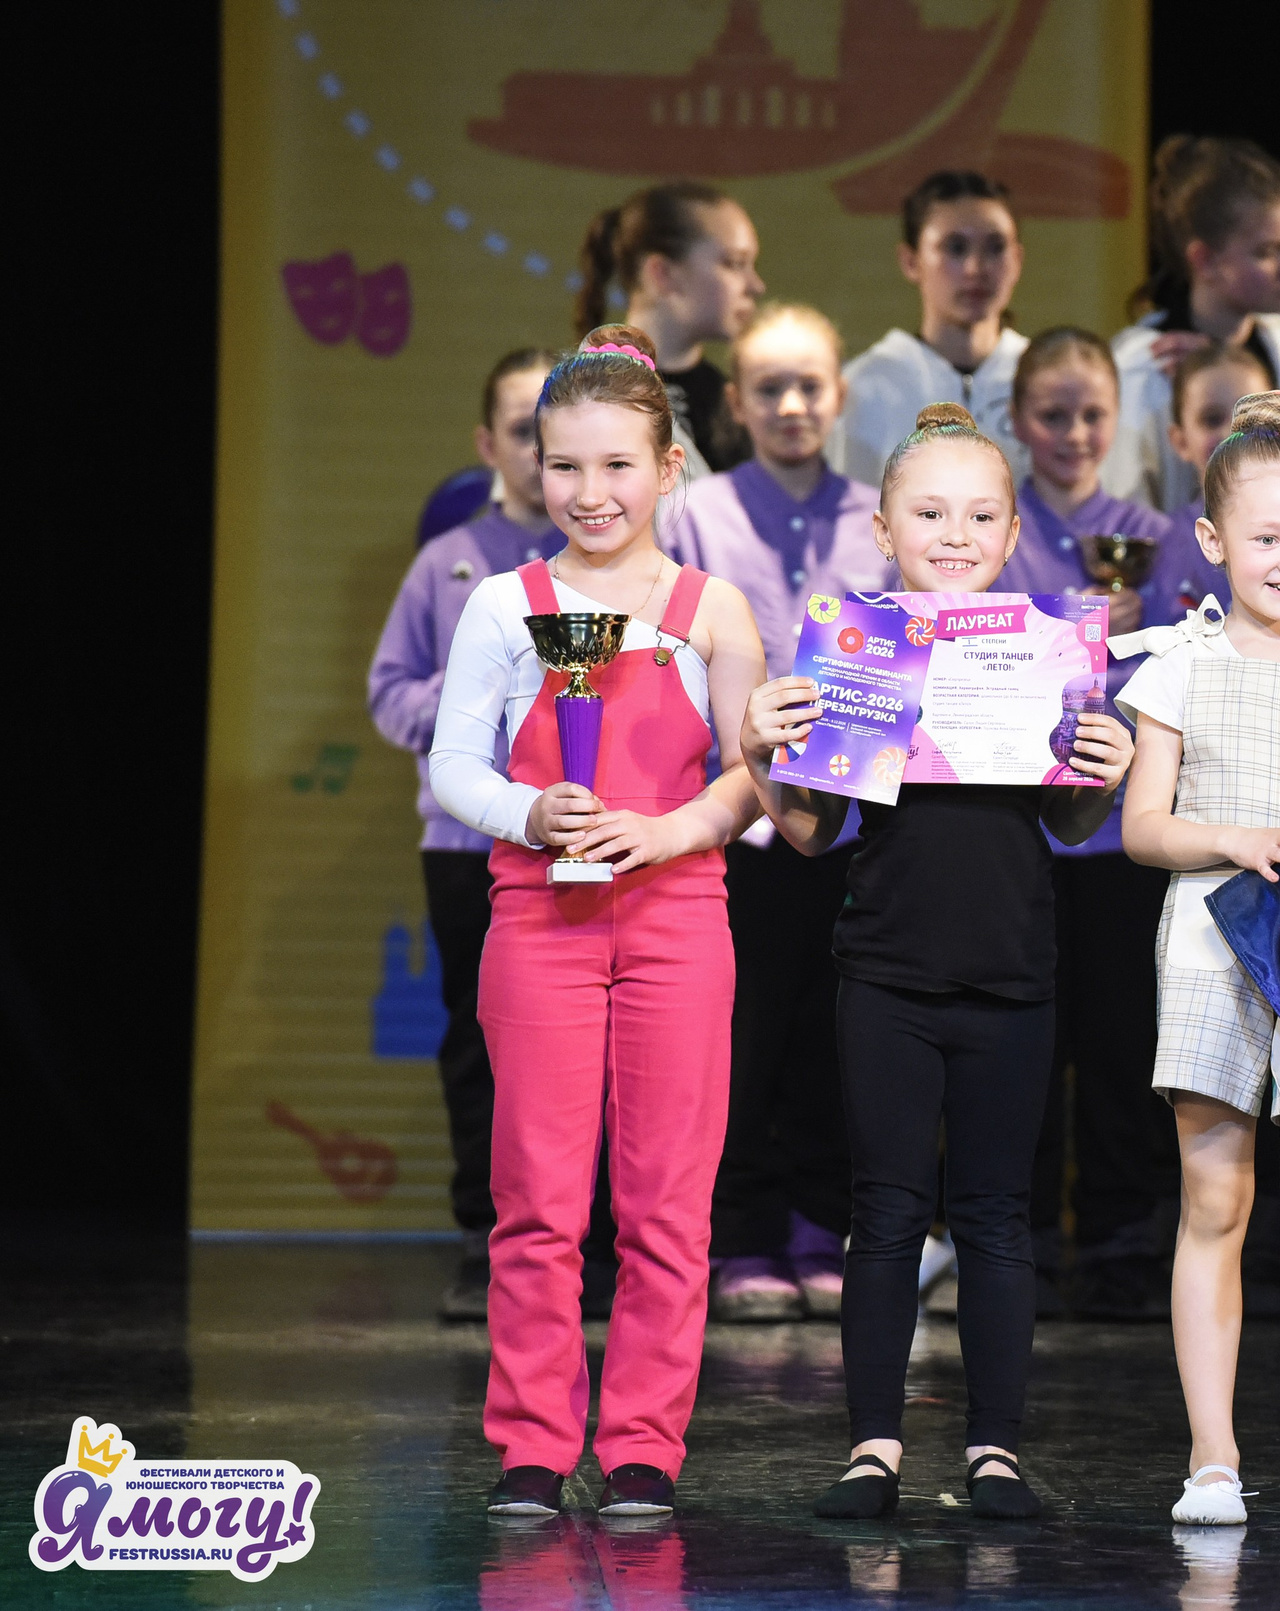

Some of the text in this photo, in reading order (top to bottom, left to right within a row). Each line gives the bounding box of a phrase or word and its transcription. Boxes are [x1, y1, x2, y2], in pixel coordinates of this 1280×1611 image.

[946, 613, 1014, 632] ЛАУРЕАТ
[867, 636, 896, 648] АРТИС
[865, 644, 895, 659] 2026
[964, 652, 1034, 661] СТУДИЯ ТАНЦЕВ
[812, 655, 913, 682] СЕРТИФИКАТ НОМИНАНТА
[822, 666, 860, 677] МЕЖДУНАРОДНОЙ
[818, 670, 839, 678] ДЕТСКОГО
[876, 682, 902, 691] ТВОРЧЕСТВА
[811, 681, 904, 712] АРТИС-2026
